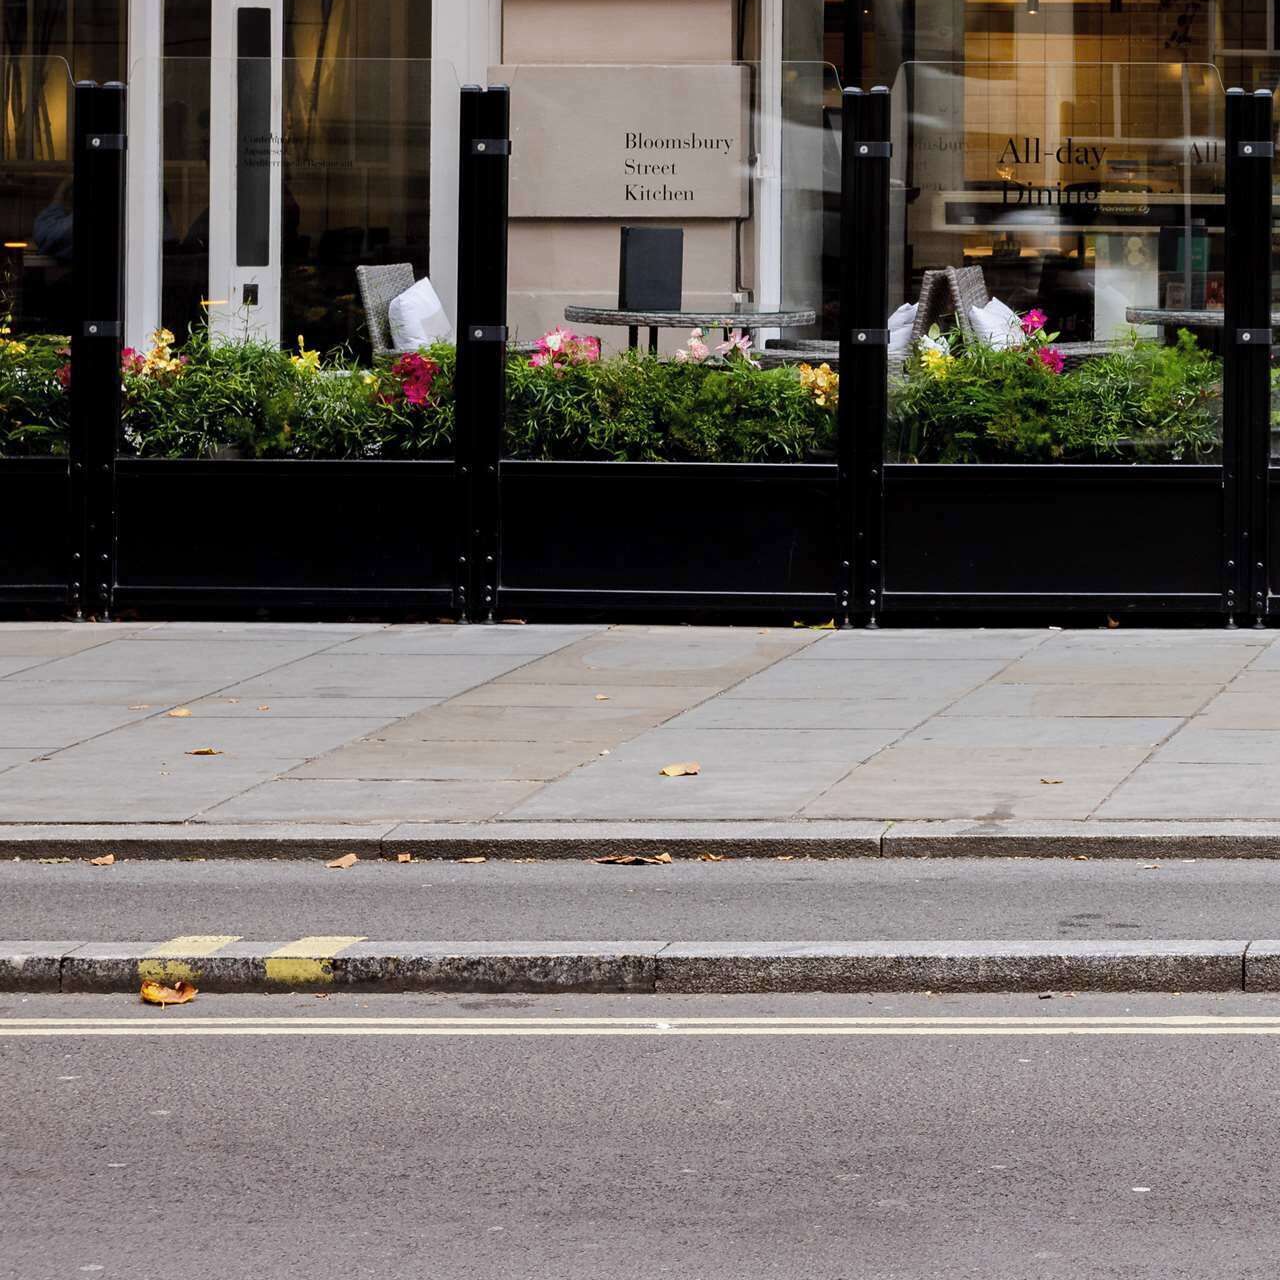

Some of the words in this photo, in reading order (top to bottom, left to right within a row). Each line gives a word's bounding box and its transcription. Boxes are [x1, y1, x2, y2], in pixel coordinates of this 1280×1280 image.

[624, 131, 735, 155] Bloomsbury
[998, 135, 1107, 171] All-day
[624, 158, 677, 176] Street
[624, 183, 695, 201] Kitchen
[1001, 181, 1099, 212] Dining
